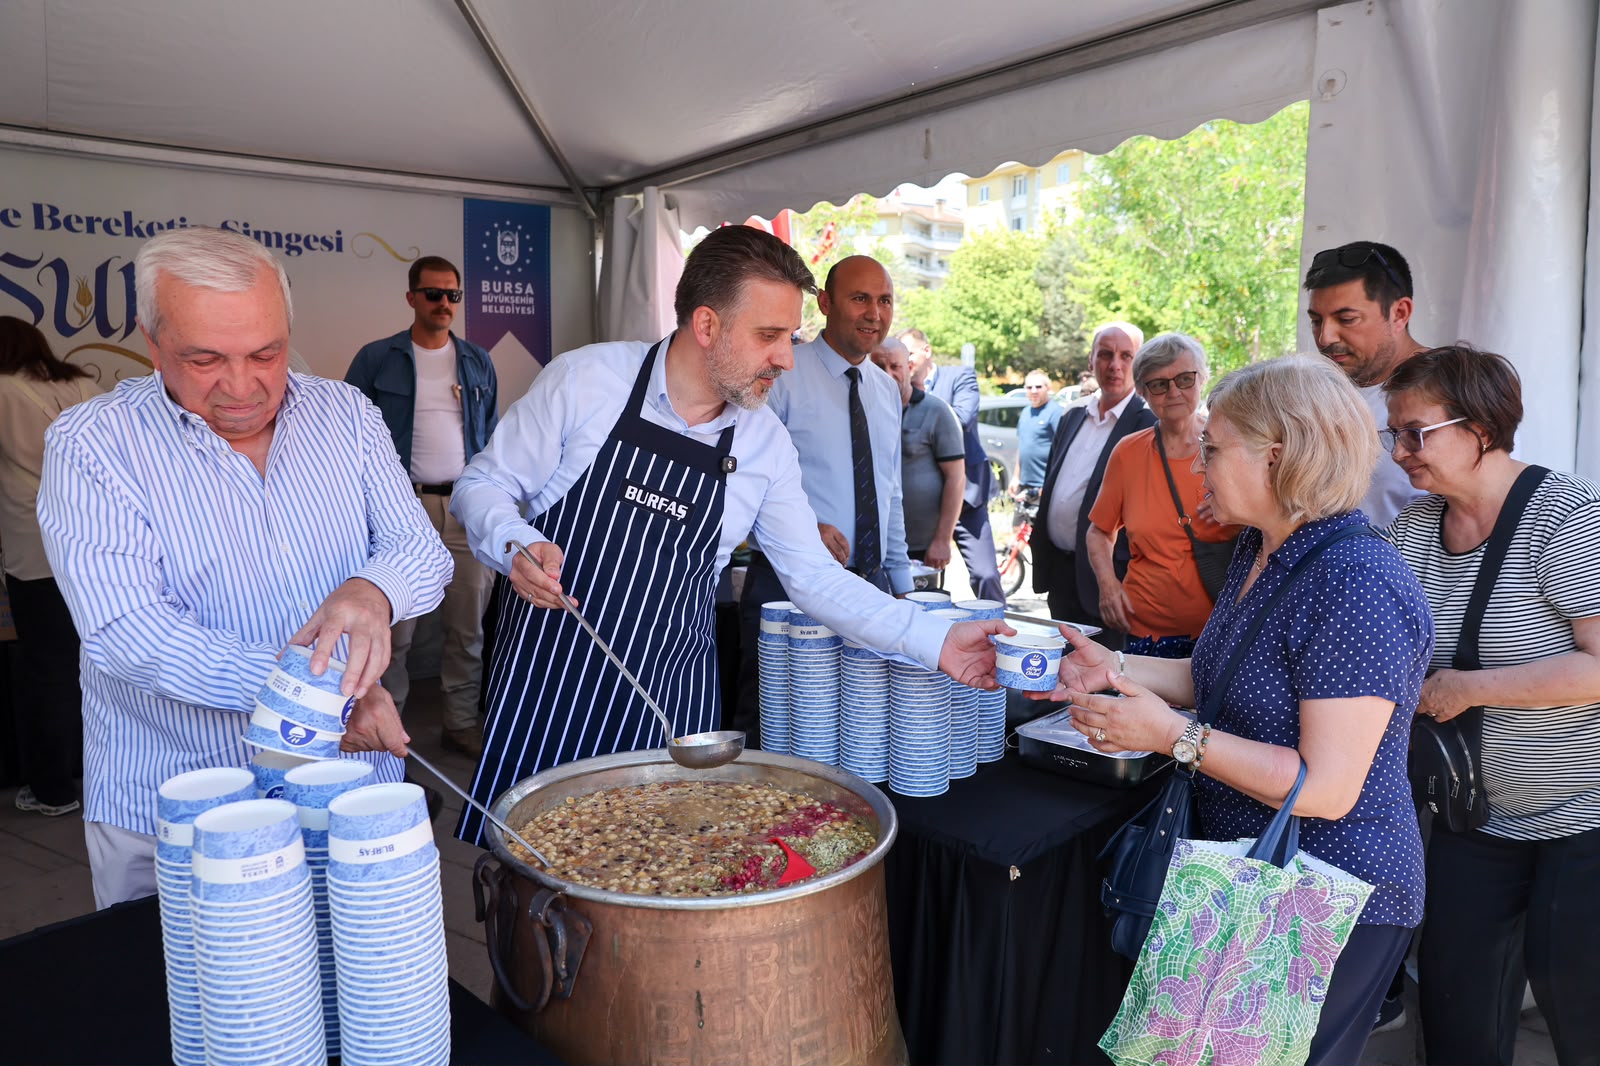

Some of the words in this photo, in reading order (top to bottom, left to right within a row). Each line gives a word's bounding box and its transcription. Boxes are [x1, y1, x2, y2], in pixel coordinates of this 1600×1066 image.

[481, 280, 535, 295] BURSA
[482, 303, 535, 315] BELEDİYESİ
[624, 485, 689, 521] BURFAŞ
